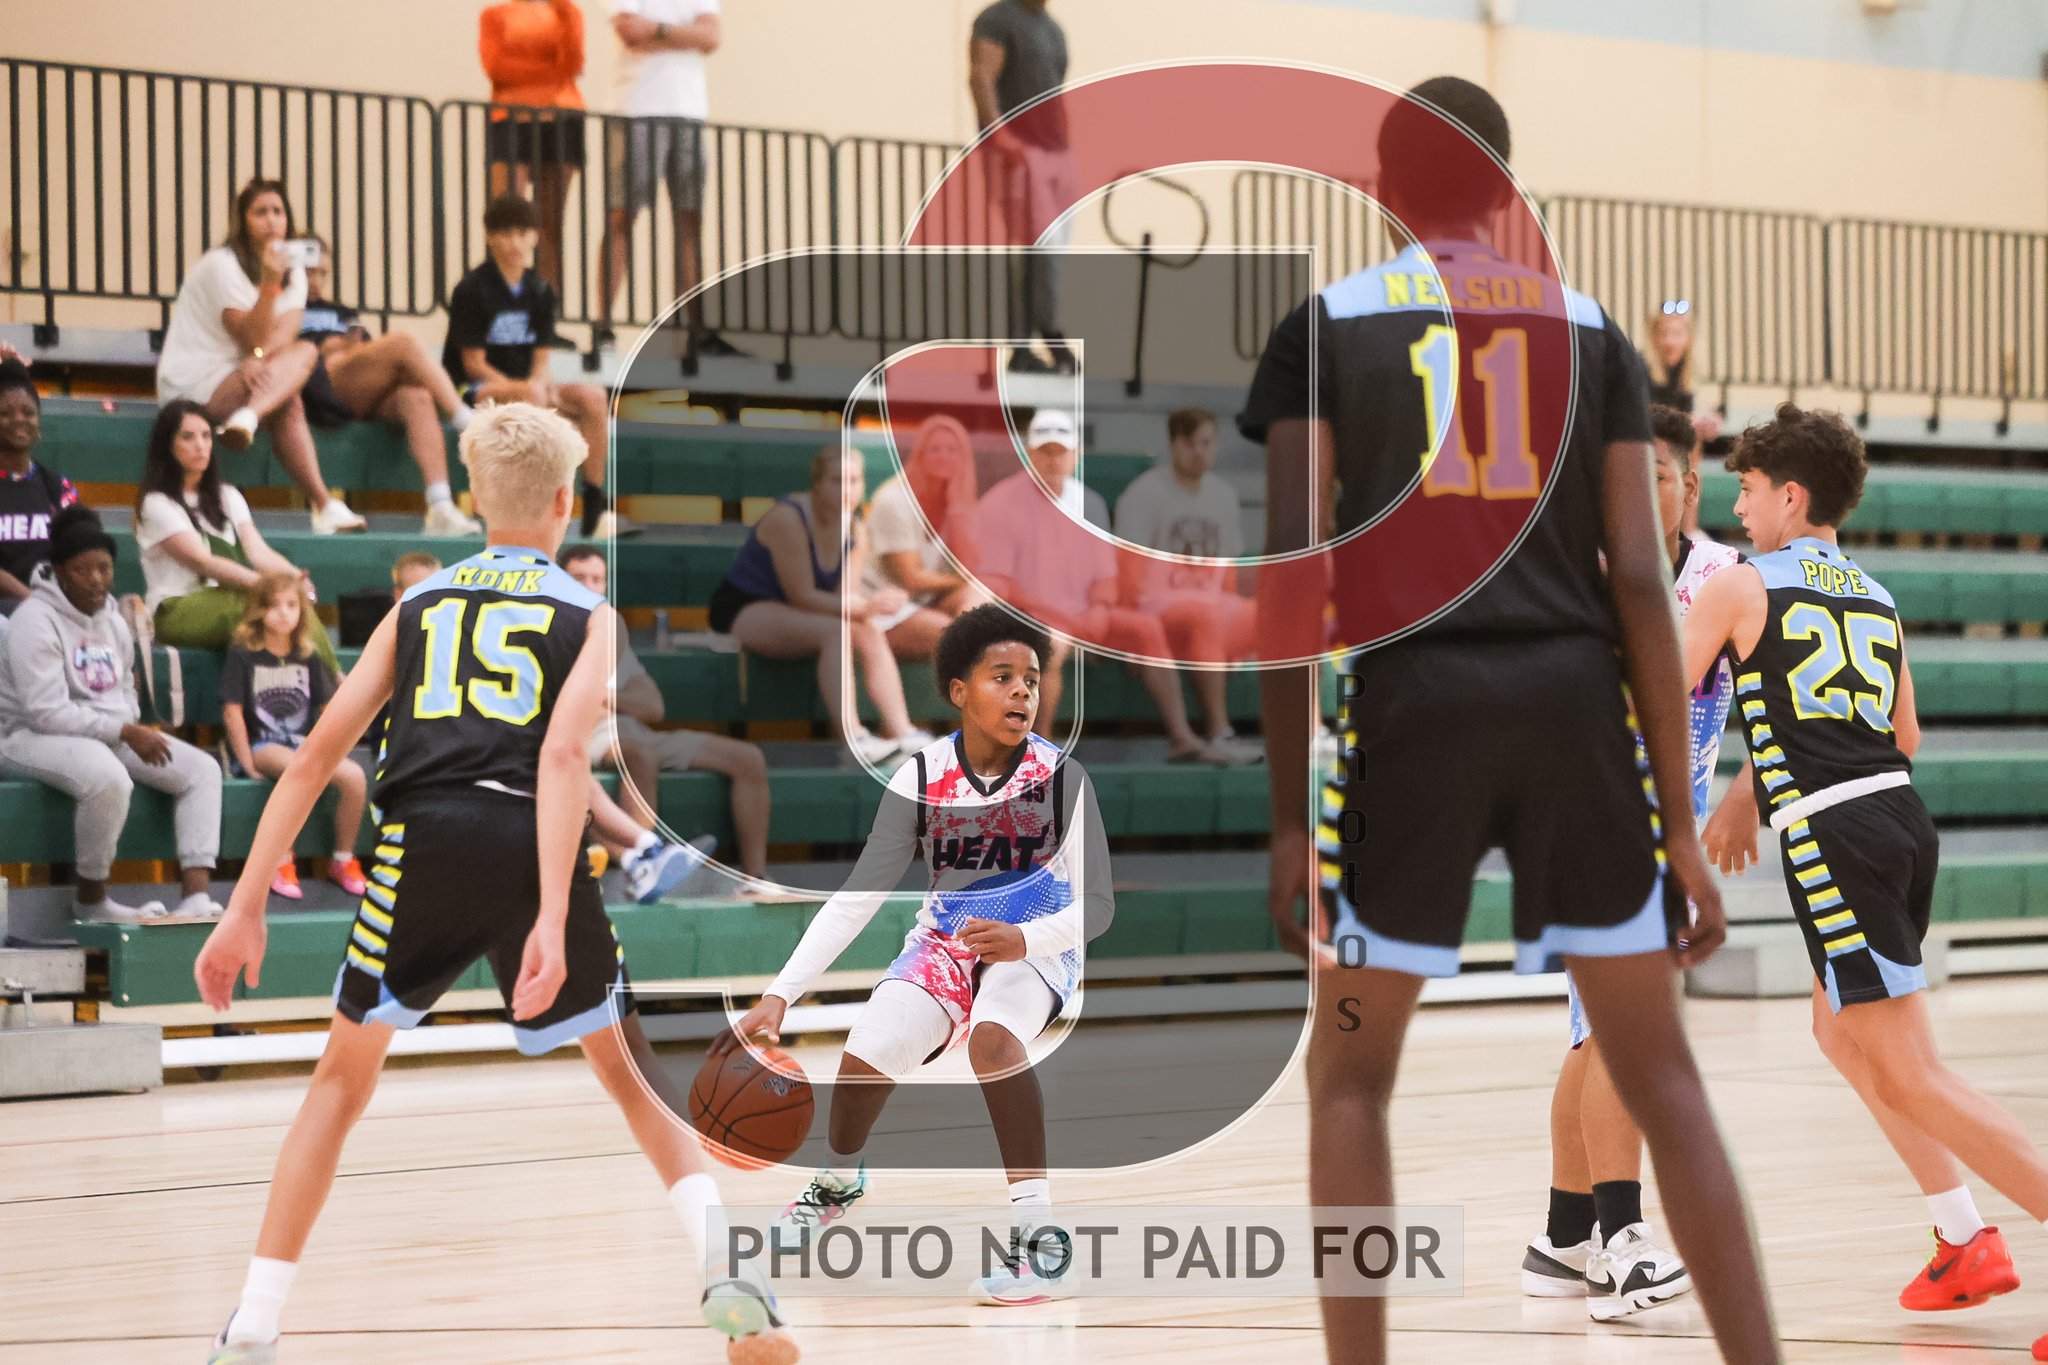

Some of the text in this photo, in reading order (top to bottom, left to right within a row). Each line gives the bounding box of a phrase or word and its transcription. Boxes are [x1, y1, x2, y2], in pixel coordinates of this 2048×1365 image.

[1382, 272, 1545, 310] NELSON
[1408, 323, 1542, 501] 11
[0, 513, 51, 541] HEA
[450, 566, 548, 594] MONK
[1799, 559, 1869, 596] POPE
[413, 597, 556, 727] 15
[1781, 601, 1898, 734] 25
[932, 823, 1052, 873] HEAT
